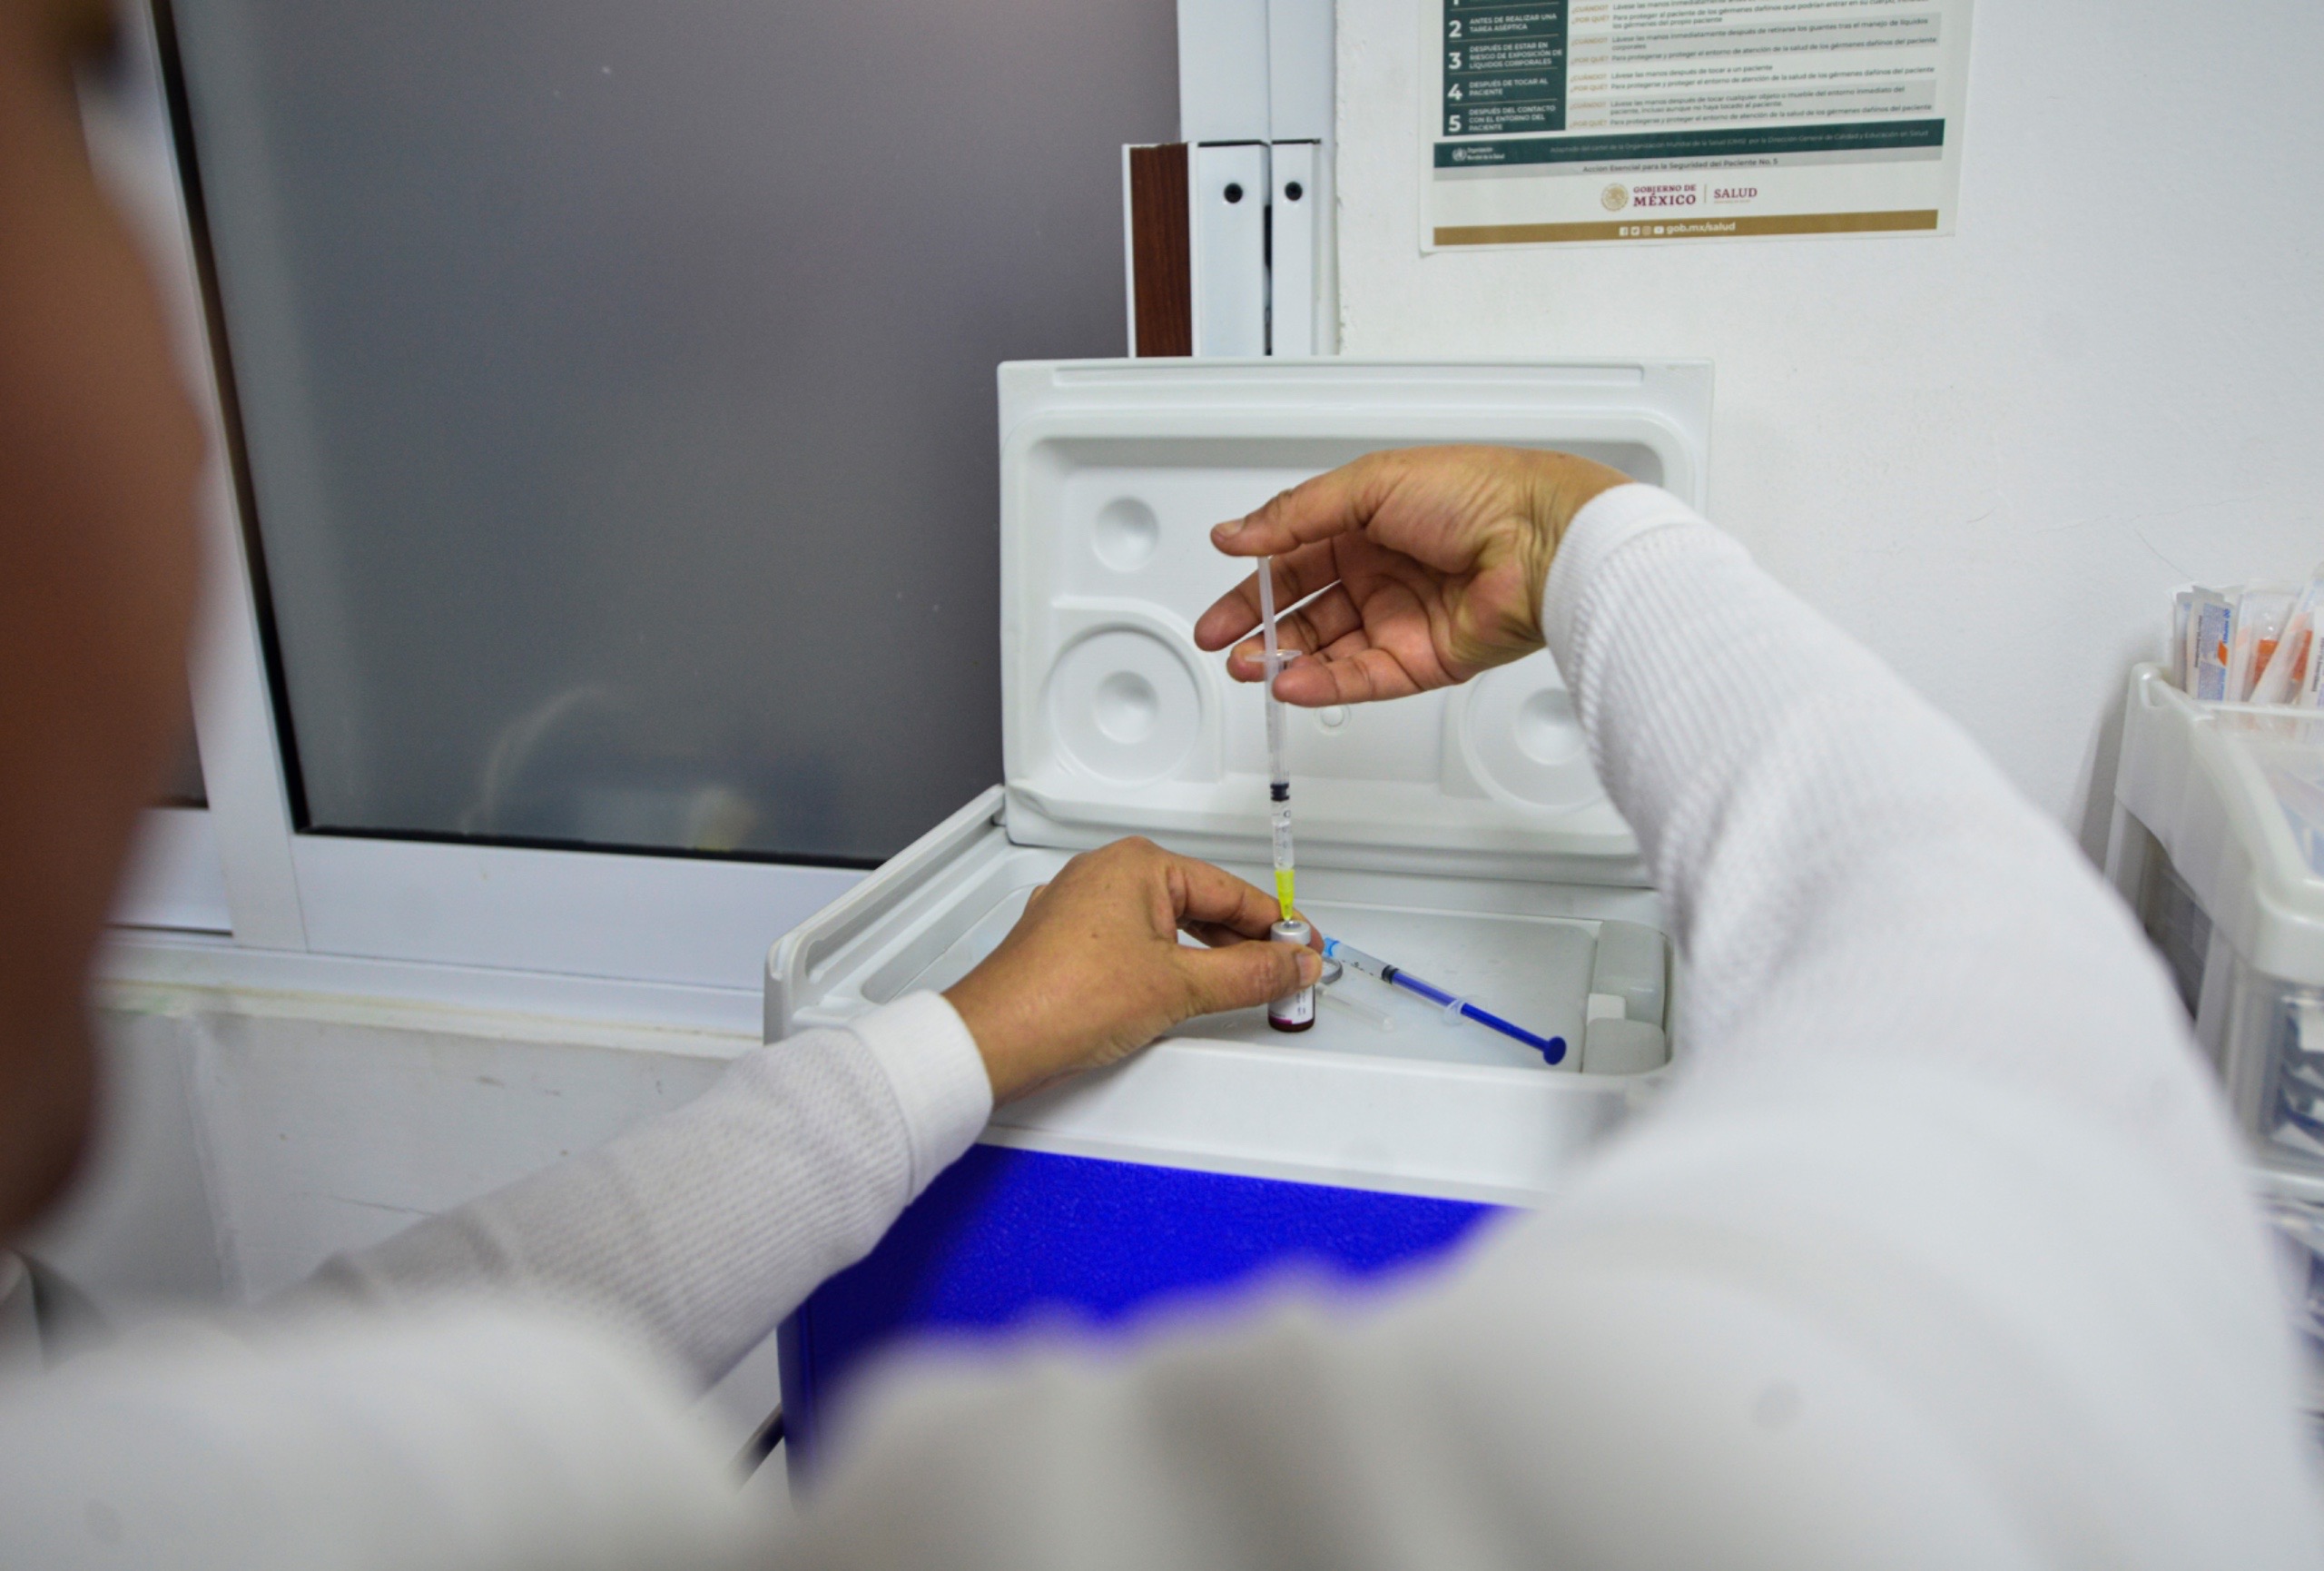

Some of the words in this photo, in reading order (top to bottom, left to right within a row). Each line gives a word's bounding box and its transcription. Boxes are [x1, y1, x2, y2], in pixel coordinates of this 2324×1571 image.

[1449, 20, 1462, 37] 2
[1494, 23, 1528, 31] ASÉPTICA
[1449, 52, 1462, 69] 3
[1504, 58, 1551, 66] CORPORALES
[1469, 80, 1500, 88] DESPUÉS
[1448, 84, 1462, 101] 4
[1448, 114, 1462, 132] 5
[1610, 163, 1640, 172] Esencial
[1669, 162, 1709, 170] Seguridad
[1724, 159, 1757, 167] Paciente
[1633, 184, 1681, 193] GOBIERNO
[1684, 183, 1697, 192] DE
[1714, 187, 1758, 199] SALUD
[1633, 193, 1696, 207] MÉXICO
[1667, 222, 1737, 234] gob.mx/salud
